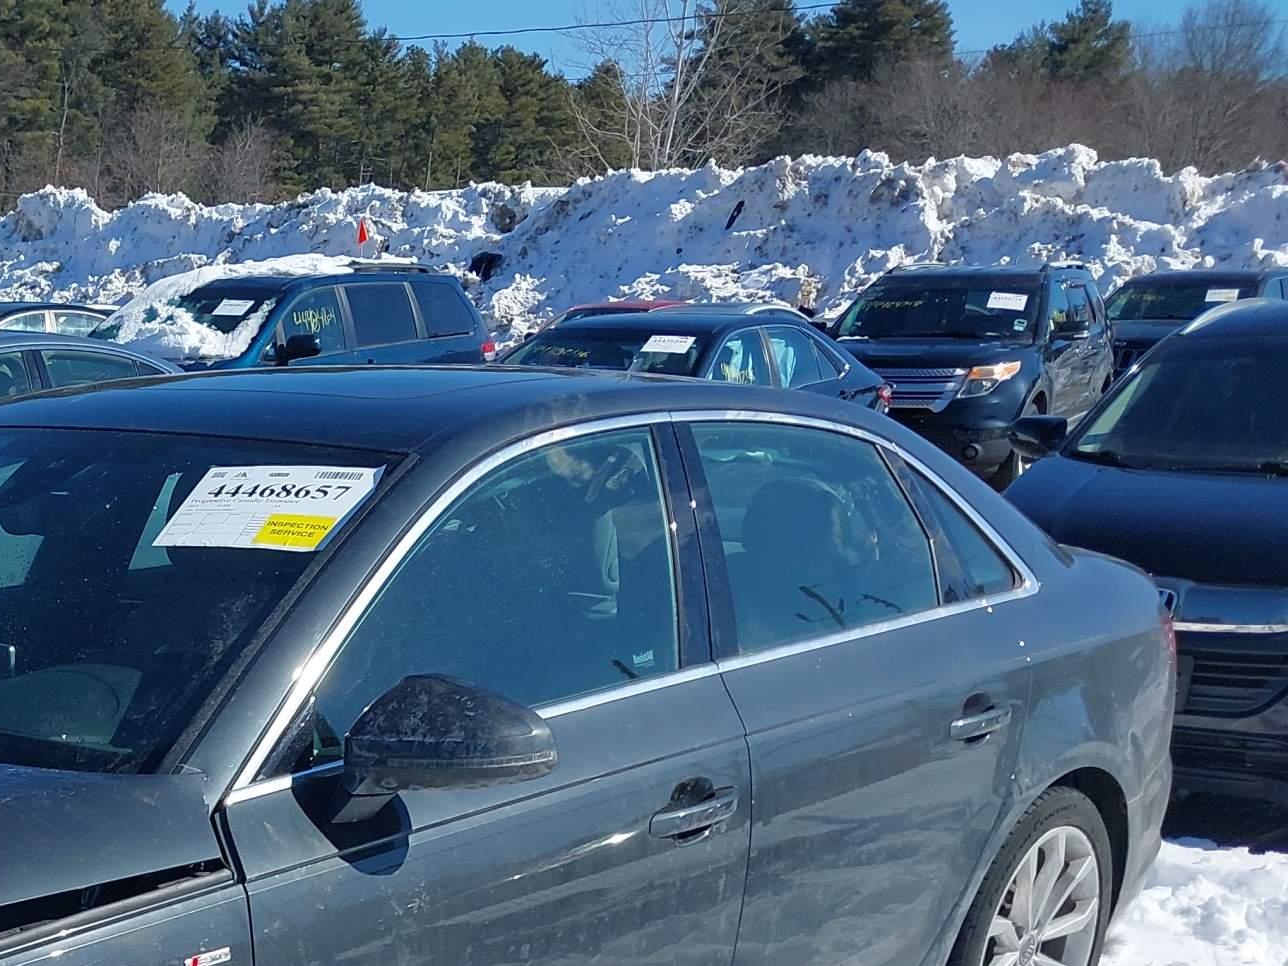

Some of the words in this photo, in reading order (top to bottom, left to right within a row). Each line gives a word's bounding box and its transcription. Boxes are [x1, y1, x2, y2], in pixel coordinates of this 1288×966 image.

[207, 483, 352, 501] 44468657
[267, 520, 329, 531] INSPECTION
[269, 529, 315, 538] SERVICE
